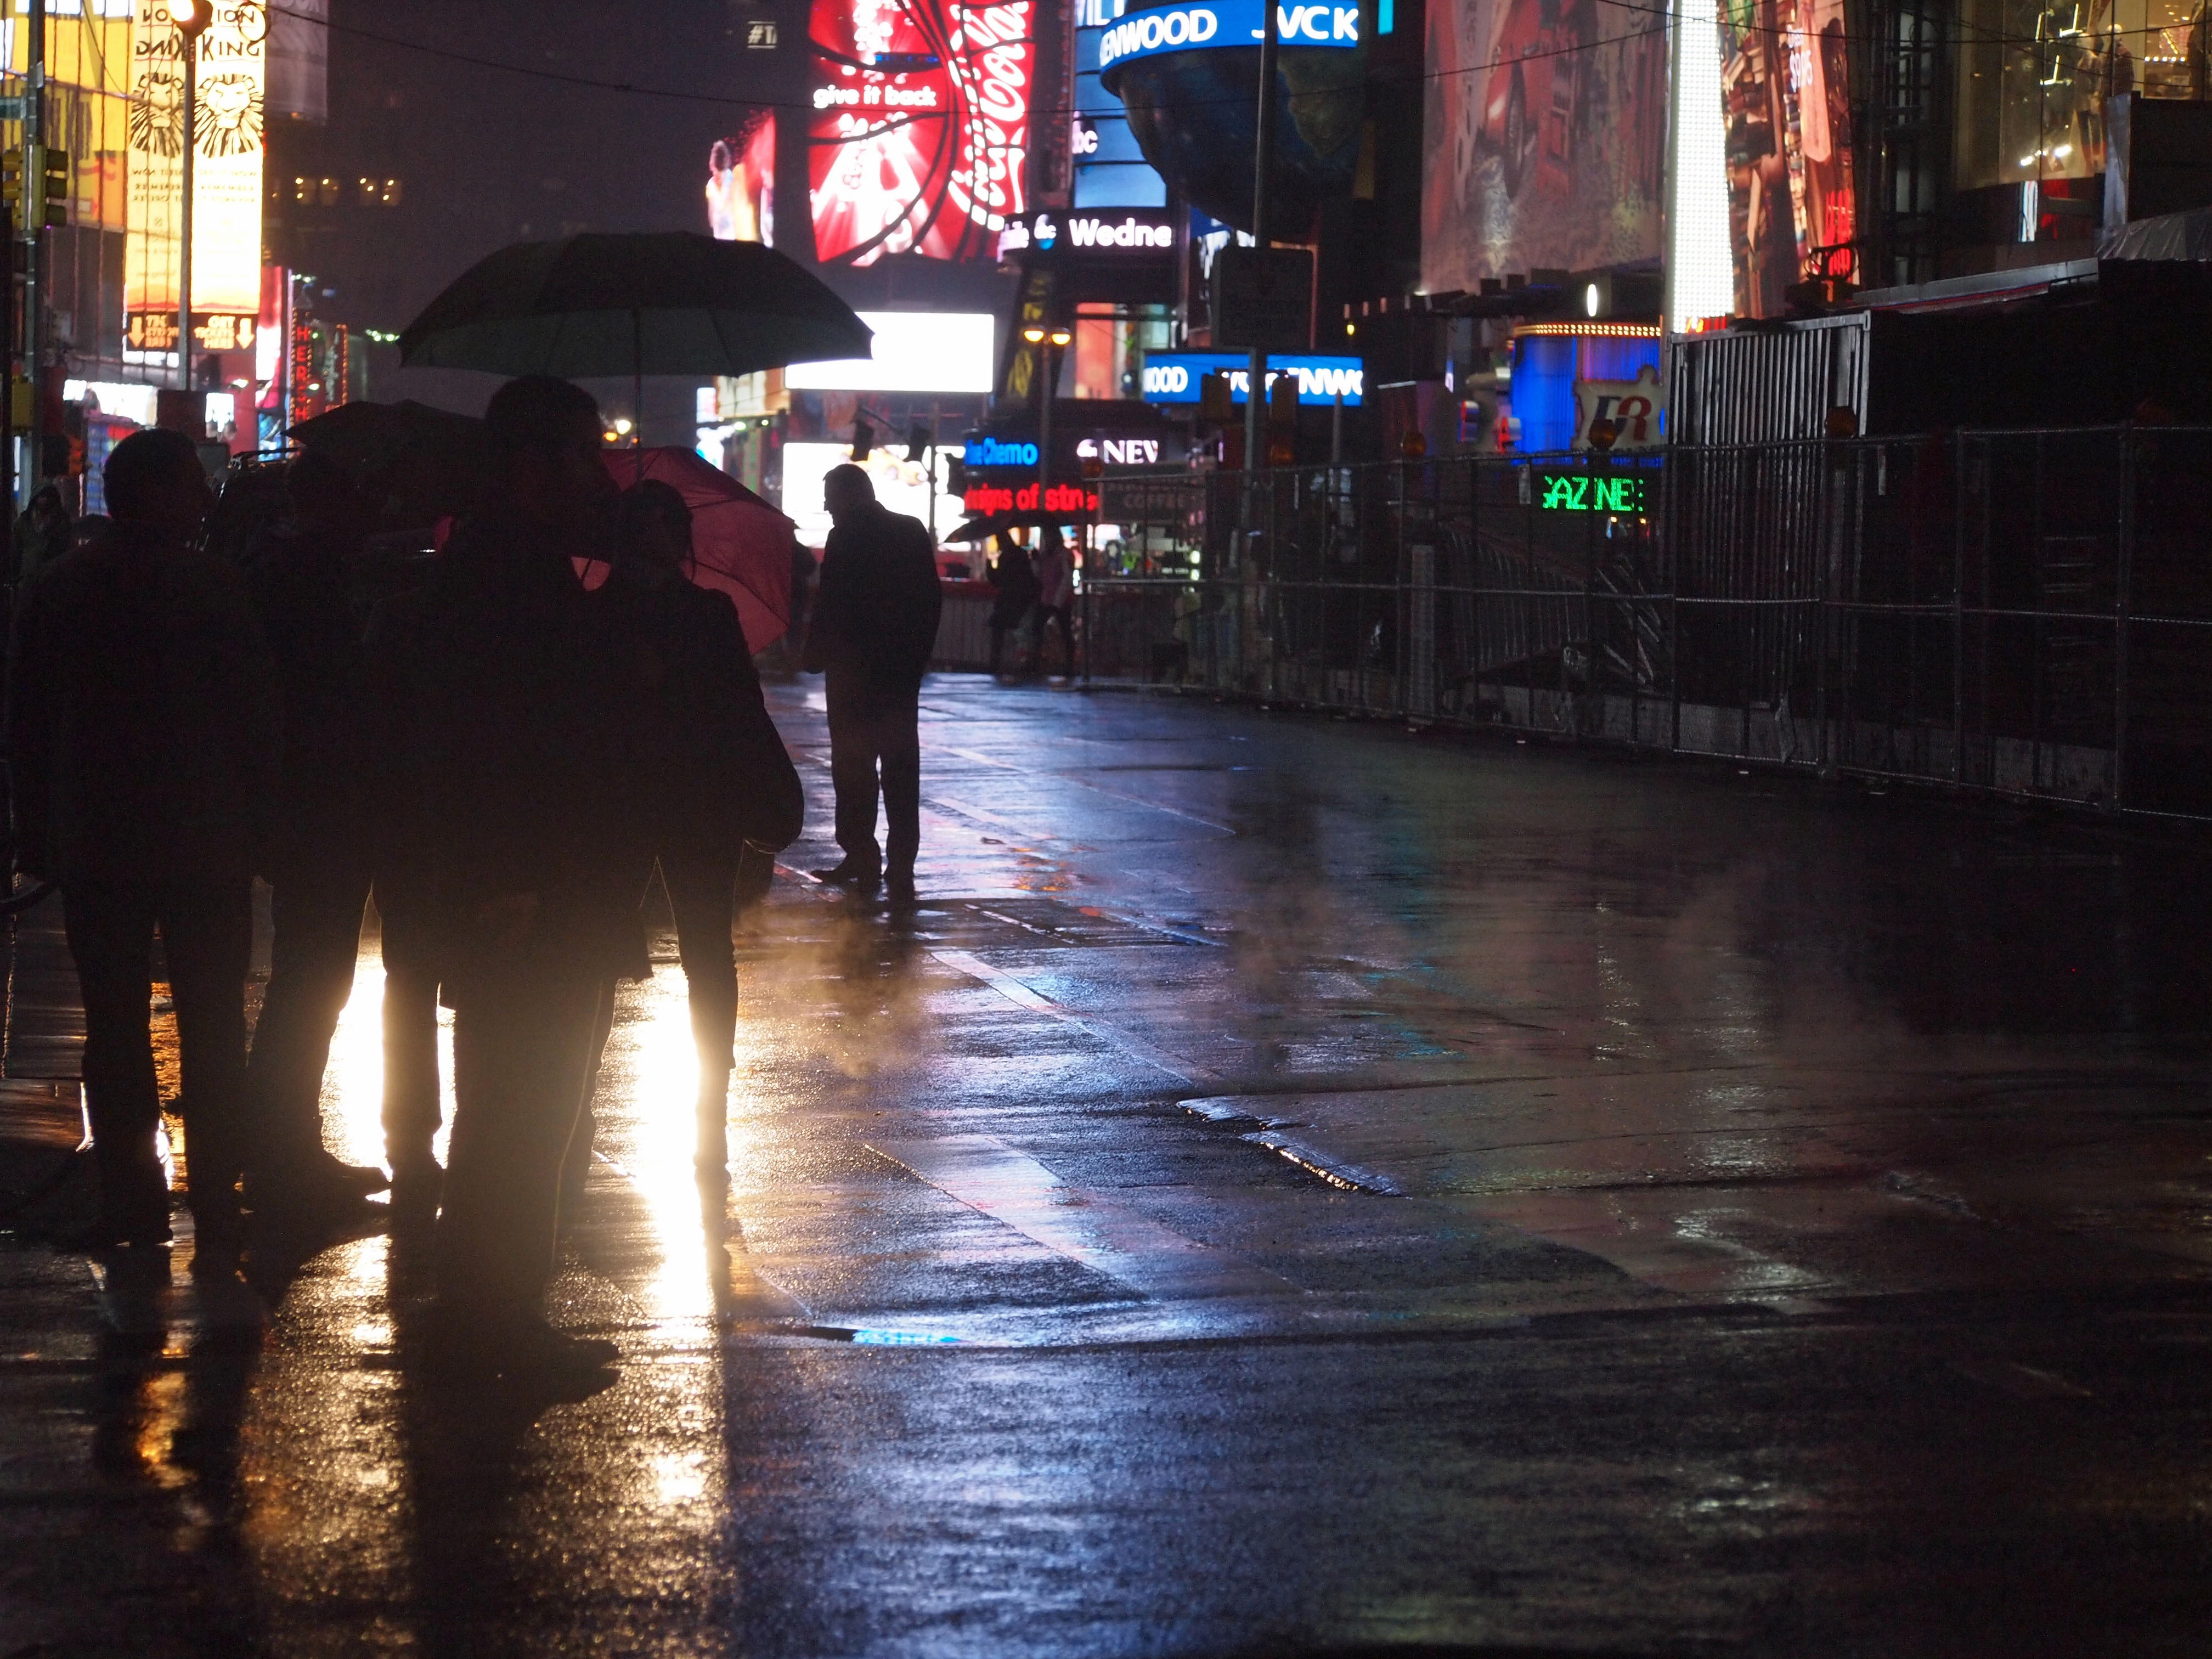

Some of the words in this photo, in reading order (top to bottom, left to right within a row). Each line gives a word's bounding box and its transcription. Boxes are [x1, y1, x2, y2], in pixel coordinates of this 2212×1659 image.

[218, 9, 254, 23] ION
[813, 84, 860, 109] give
[864, 84, 882, 104] it
[885, 84, 936, 106] back
[1069, 217, 1172, 247] Wedne
[1016, 482, 1040, 510] of
